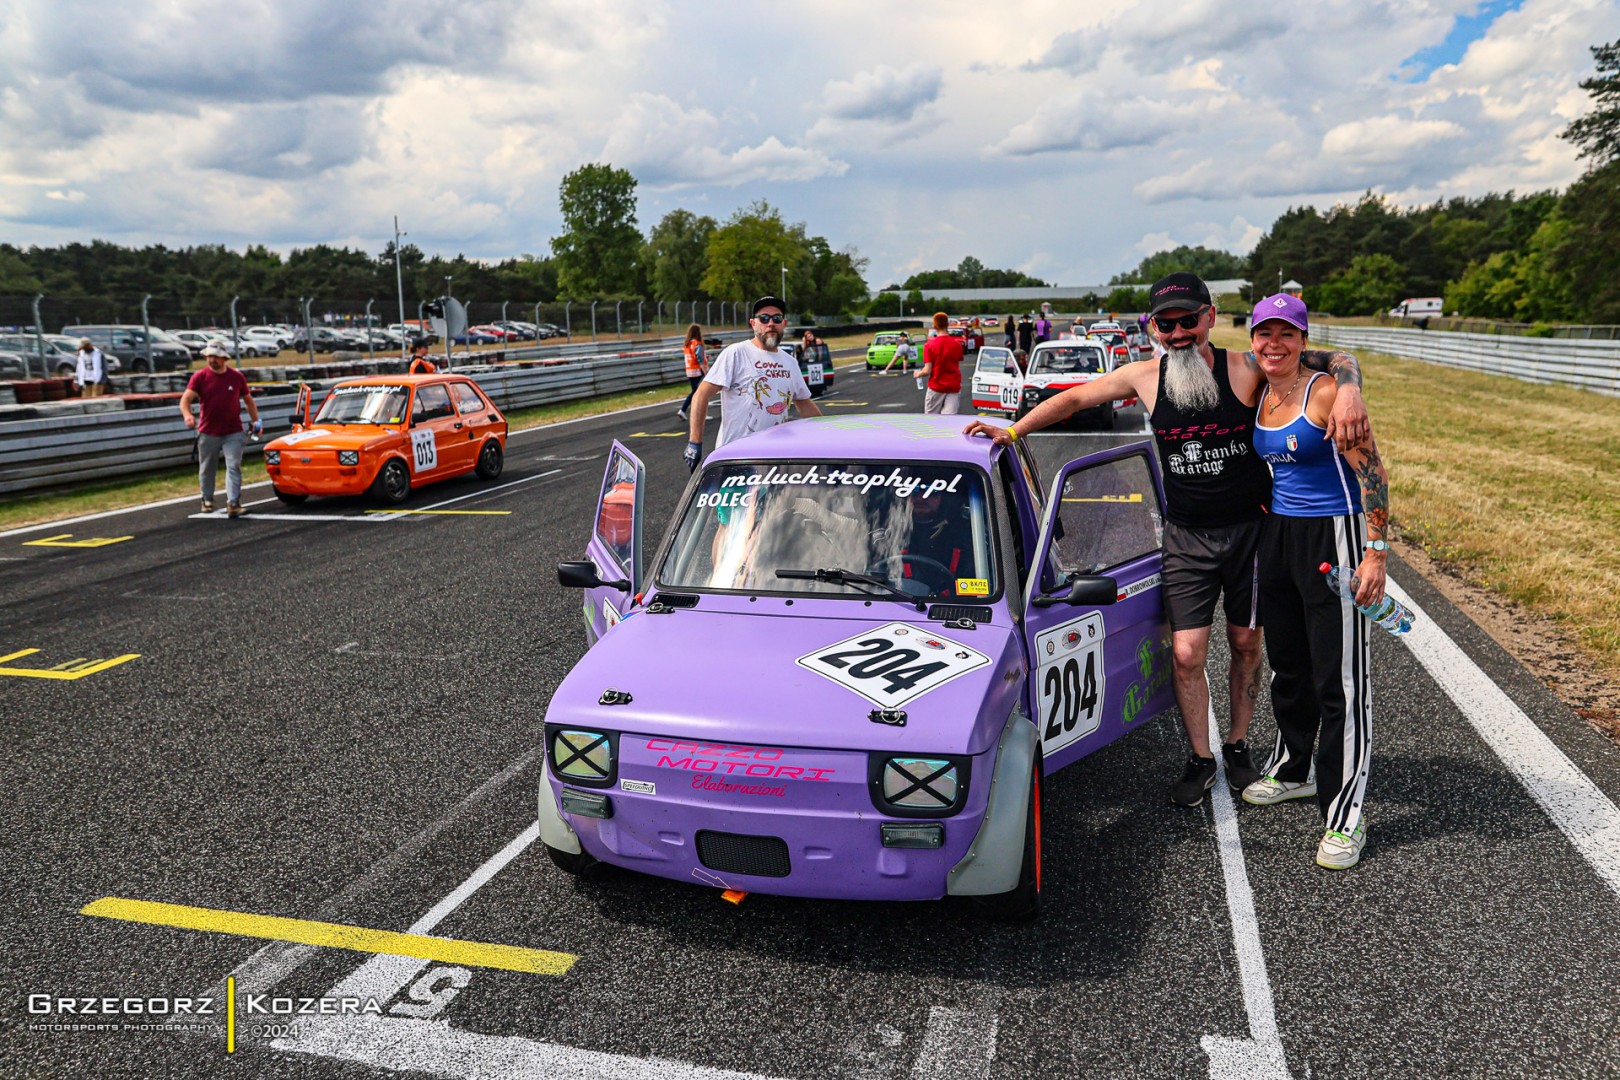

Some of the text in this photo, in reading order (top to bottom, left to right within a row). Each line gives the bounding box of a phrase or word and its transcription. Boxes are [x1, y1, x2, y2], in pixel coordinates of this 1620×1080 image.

[810, 370, 821, 382] 021
[1002, 387, 1019, 405] 019
[416, 442, 434, 467] 013
[1182, 440, 1249, 463] Franky
[1168, 453, 1225, 476] Garage
[721, 466, 962, 498] maluch-trophy.pl
[696, 491, 751, 508] BOLEC
[818, 638, 950, 695] 204
[1044, 650, 1098, 743] 204
[645, 738, 784, 761] CAZZO
[656, 755, 836, 782] MOTORI
[691, 774, 788, 797] Elaborazioni
